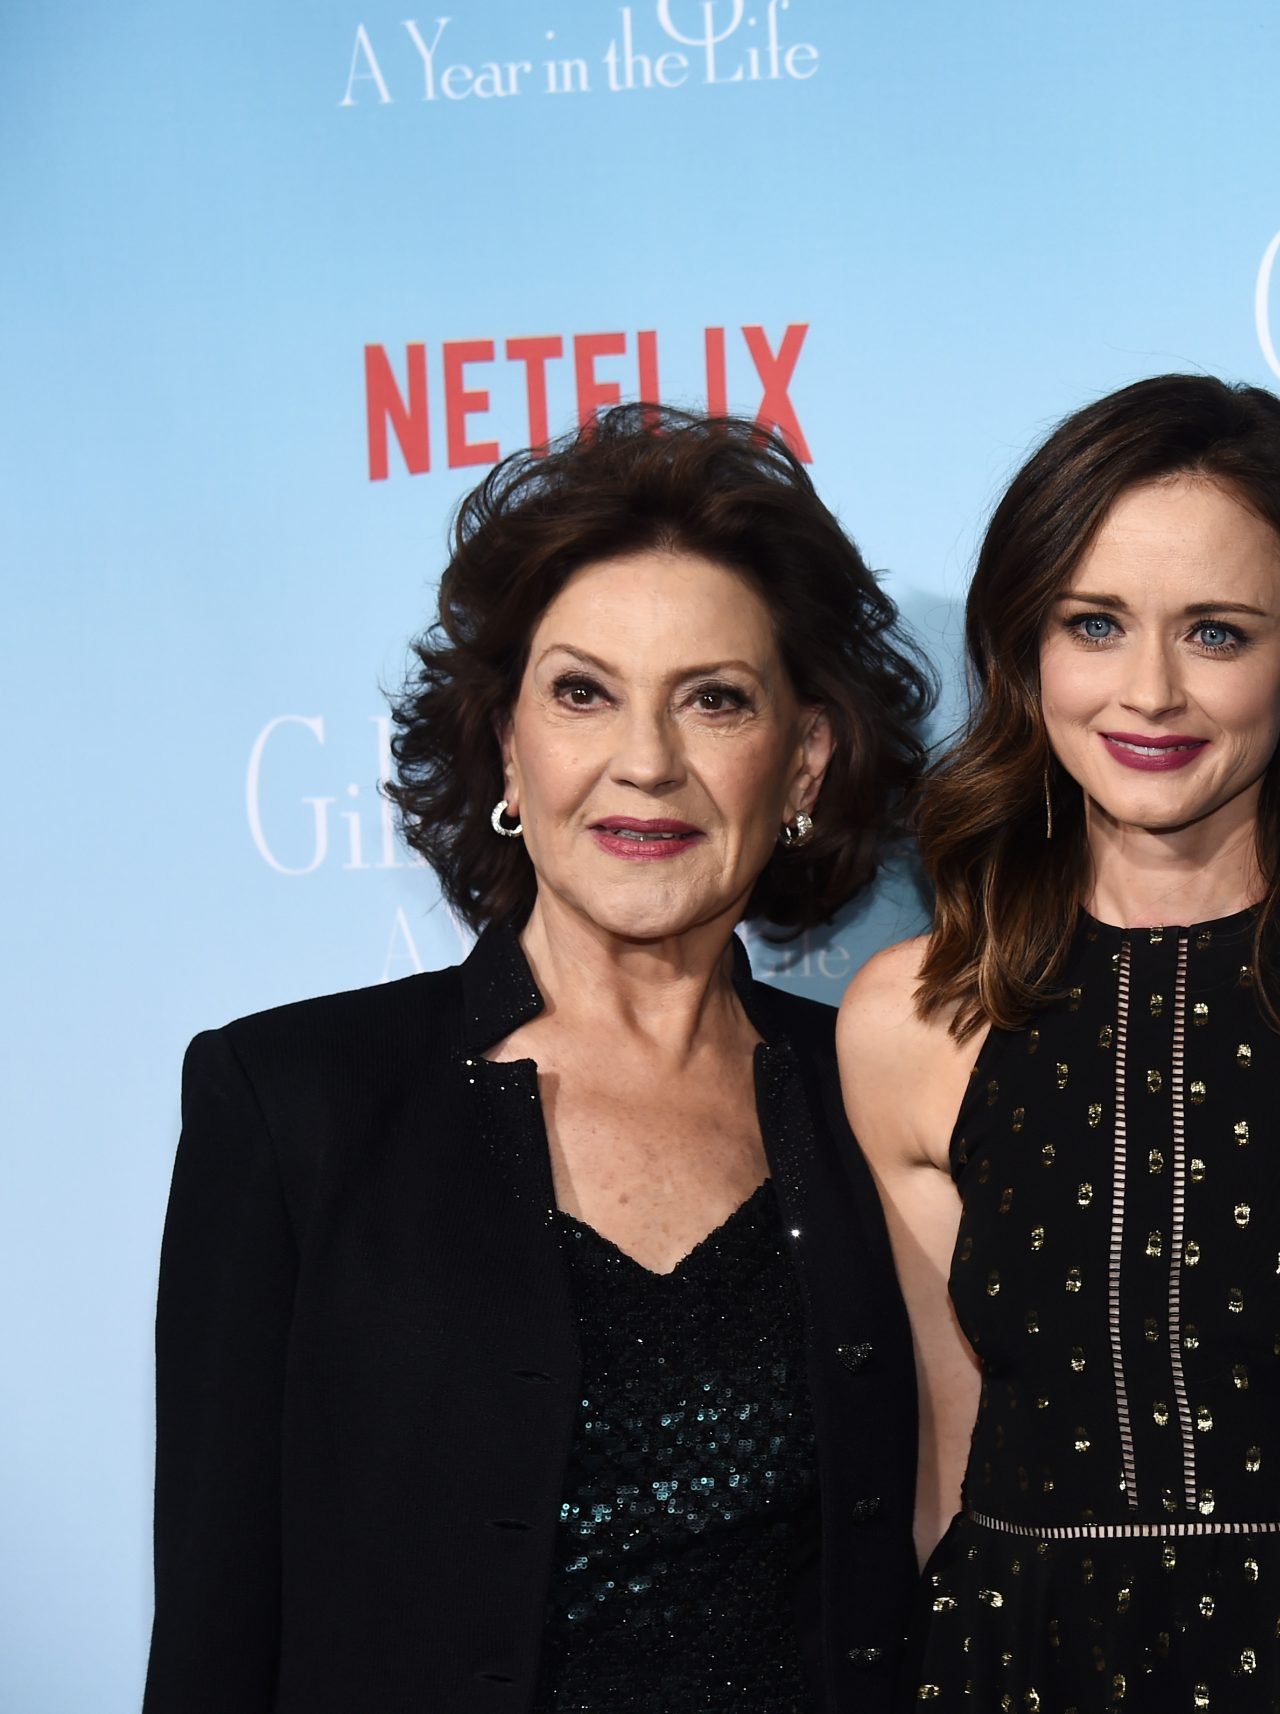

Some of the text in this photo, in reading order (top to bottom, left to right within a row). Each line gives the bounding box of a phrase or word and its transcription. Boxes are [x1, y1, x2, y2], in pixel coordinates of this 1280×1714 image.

[338, 22, 394, 107] A
[401, 16, 533, 101] Year
[543, 29, 592, 94] in
[602, 6, 690, 92] the
[700, 0, 820, 84] Life
[245, 714, 432, 876] Gil
